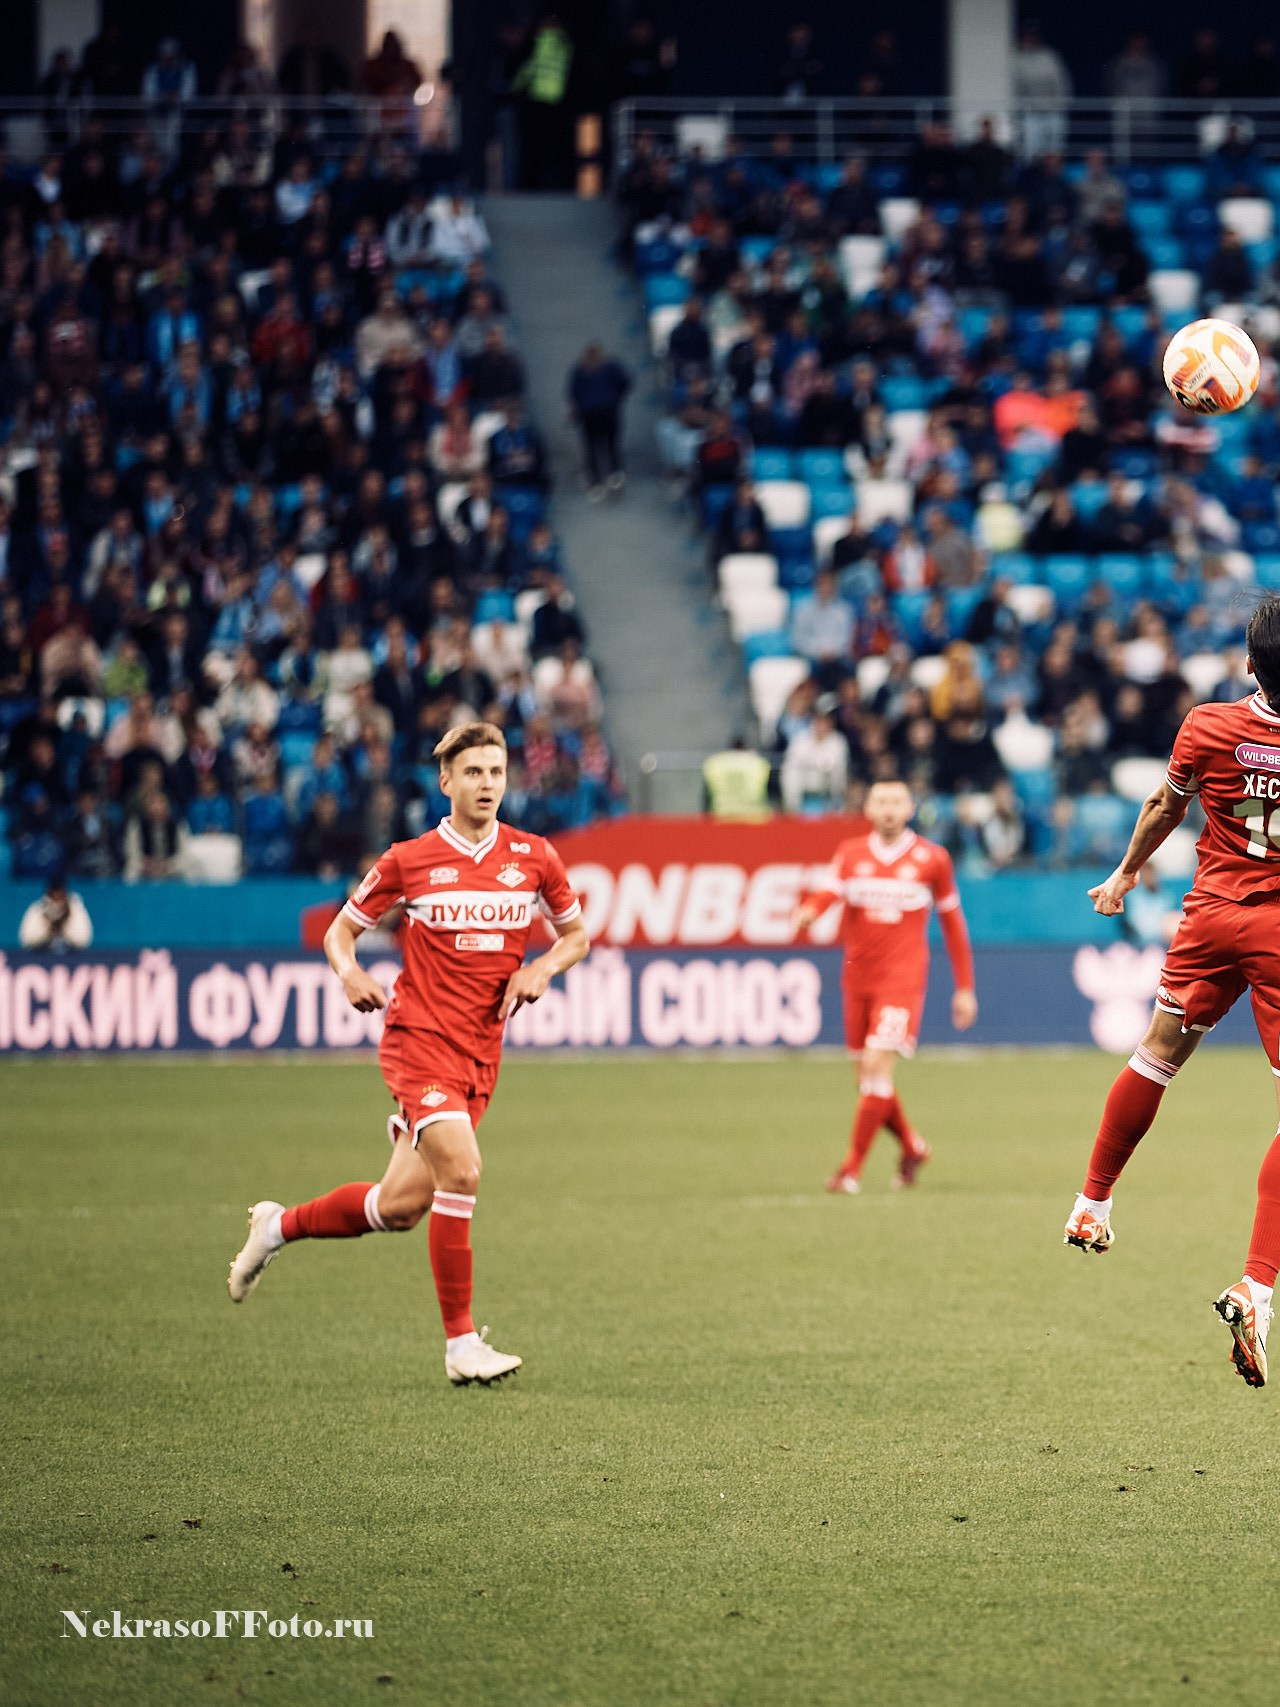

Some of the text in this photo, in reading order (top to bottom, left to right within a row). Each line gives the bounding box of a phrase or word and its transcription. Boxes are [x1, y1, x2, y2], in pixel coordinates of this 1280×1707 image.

[544, 863, 845, 946] ONBET
[0, 947, 178, 1049] СКИЙ
[640, 958, 822, 1047] СОЮЗ
